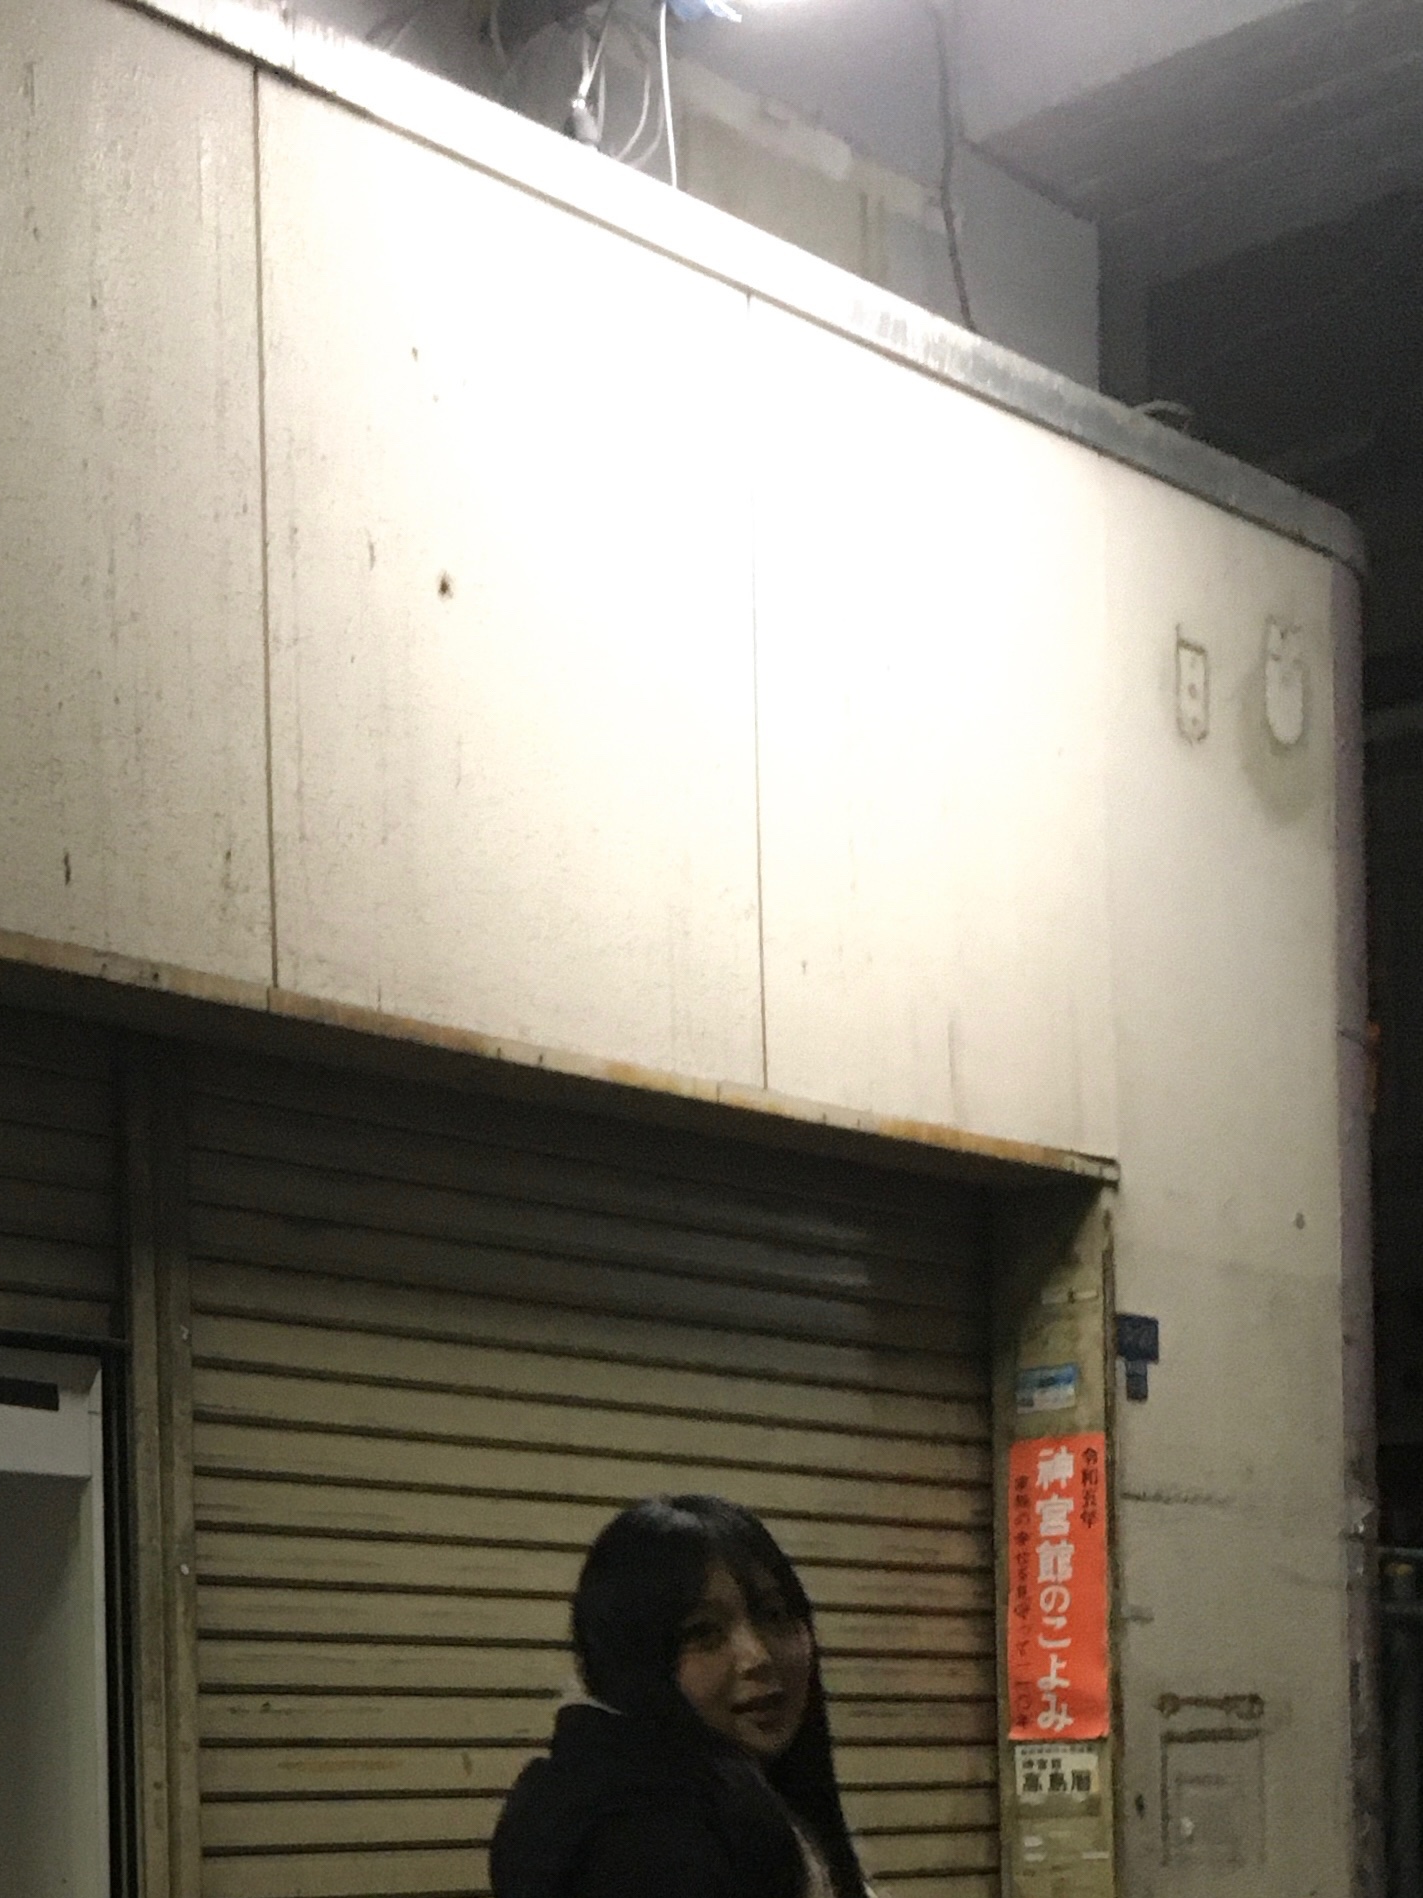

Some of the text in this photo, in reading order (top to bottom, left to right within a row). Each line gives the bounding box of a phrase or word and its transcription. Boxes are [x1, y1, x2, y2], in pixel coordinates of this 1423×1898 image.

[1036, 1445, 1075, 1734] 神宮館のこよみ
